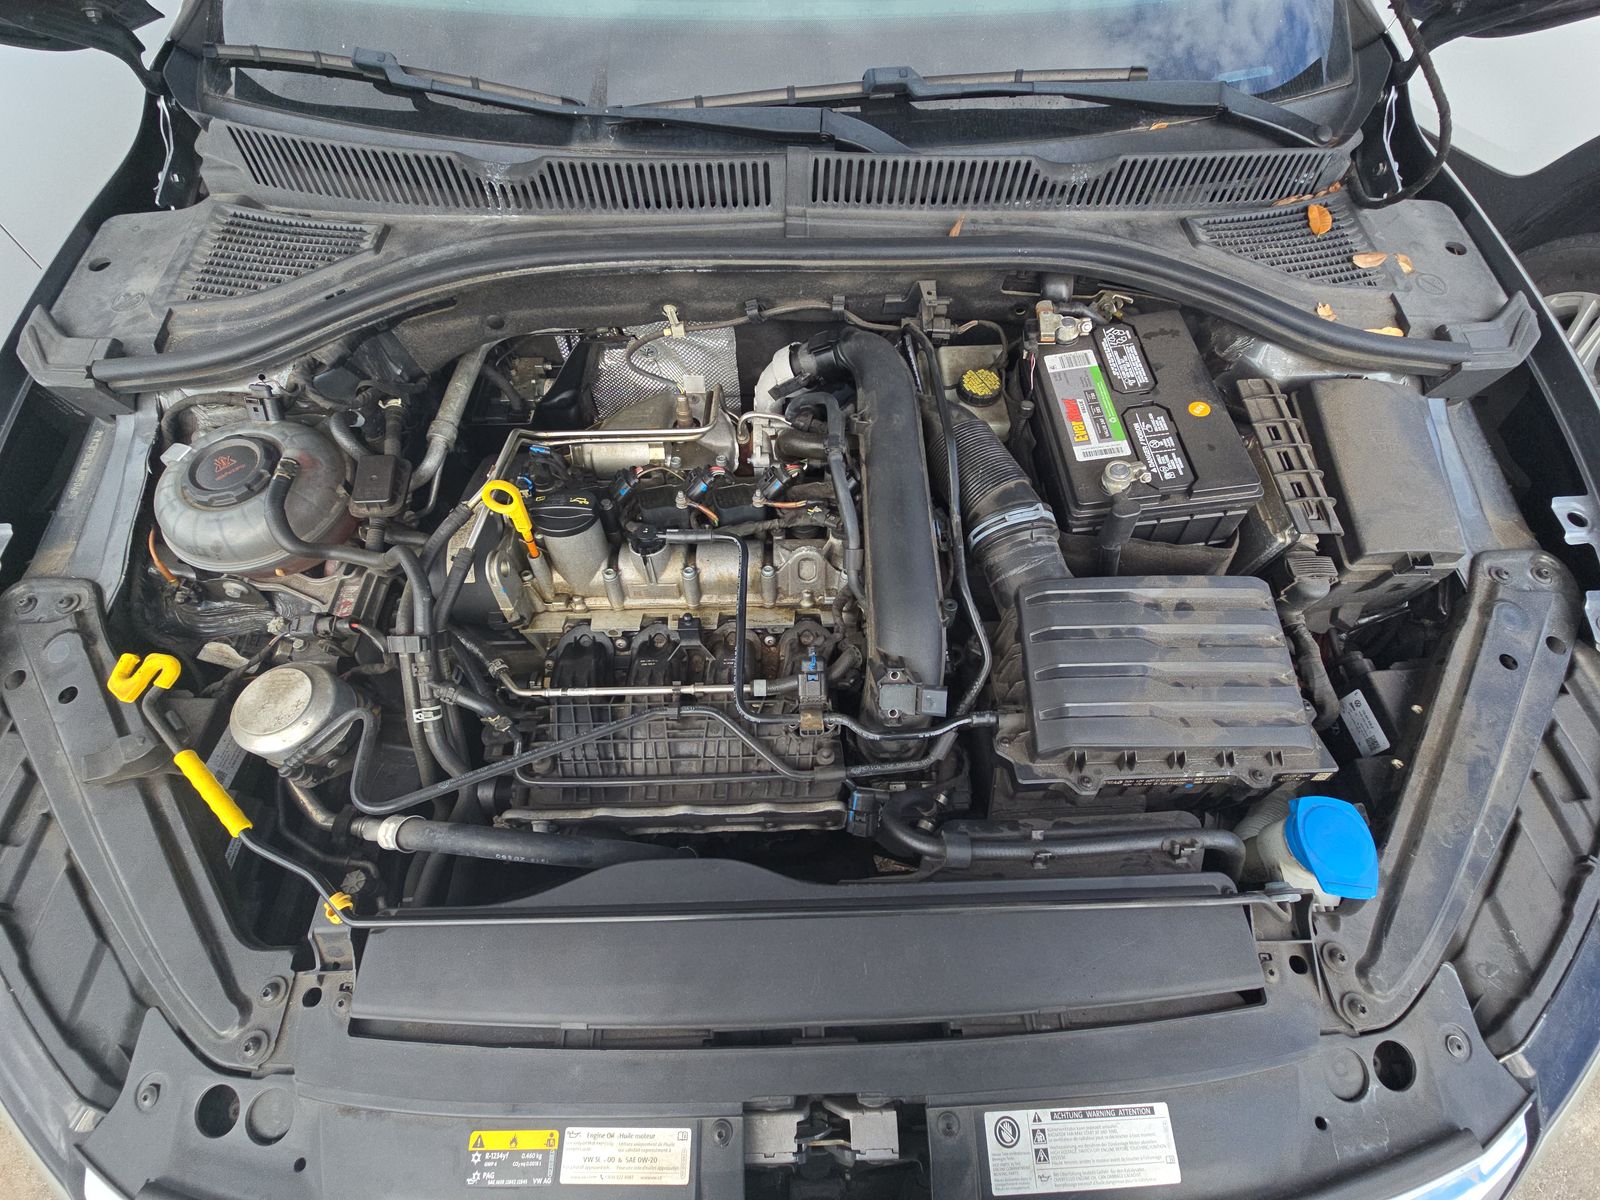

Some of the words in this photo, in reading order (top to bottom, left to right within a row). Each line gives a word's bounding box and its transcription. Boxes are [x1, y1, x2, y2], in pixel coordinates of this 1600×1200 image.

[1133, 422, 1145, 442] POISON
[1142, 446, 1155, 468] DANGER
[1053, 1111, 1083, 1120] ACHTUNG
[1086, 1109, 1116, 1118] WARNING
[1118, 1107, 1151, 1116] ATTENTION
[587, 1132, 605, 1140] Engine
[485, 1151, 509, 1160] R-1234yf
